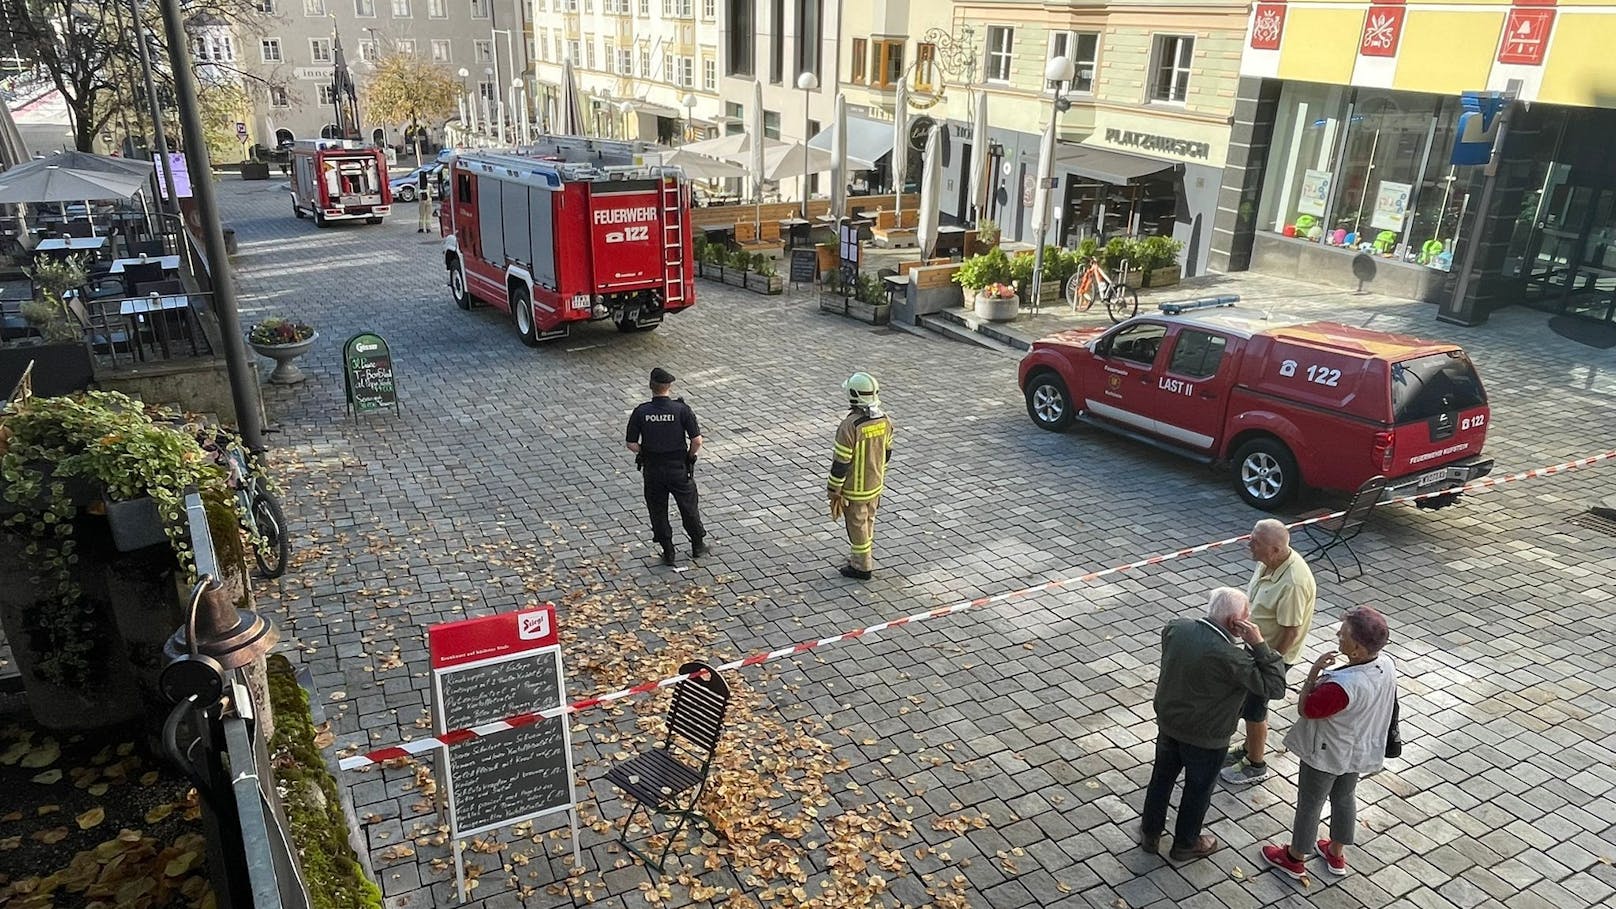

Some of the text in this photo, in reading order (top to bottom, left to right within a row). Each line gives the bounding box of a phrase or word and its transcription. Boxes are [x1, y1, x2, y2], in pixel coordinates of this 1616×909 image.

[1105, 128, 1210, 160] PLATZHIRSCH
[594, 207, 658, 225] FEUERWEHR
[624, 226, 648, 242] 122
[1307, 364, 1342, 386] 122
[1158, 376, 1193, 396] LAST II
[645, 414, 674, 422] POLIZEI
[1471, 414, 1484, 428] 122
[1409, 443, 1468, 464] FEUERWEHR KUFSTEIN
[523, 616, 544, 632] Stiegl
